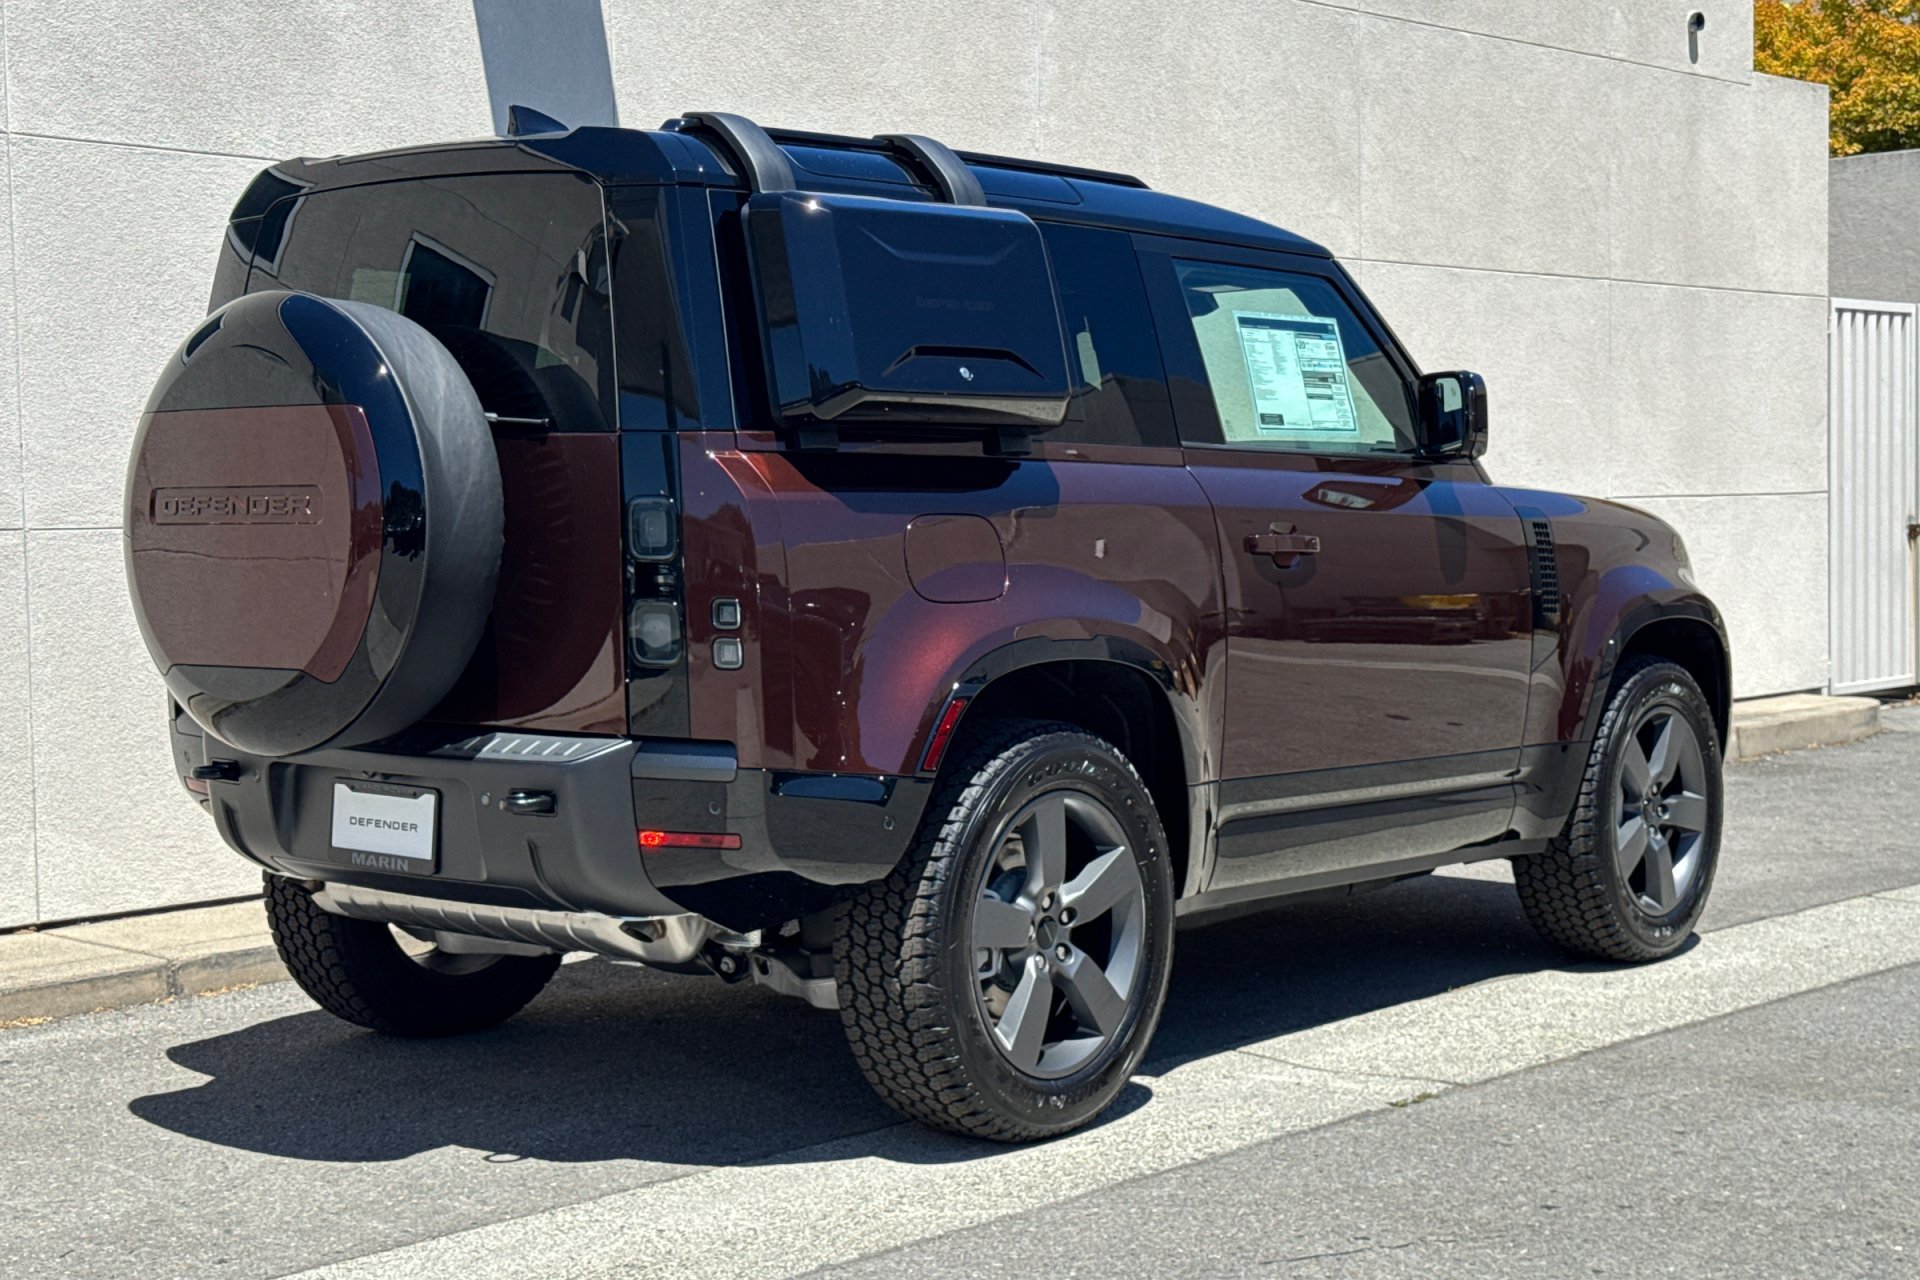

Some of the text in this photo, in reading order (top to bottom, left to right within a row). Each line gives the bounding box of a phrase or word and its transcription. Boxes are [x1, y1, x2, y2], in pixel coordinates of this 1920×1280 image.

[163, 495, 312, 516] DEFENDER
[349, 816, 418, 833] DEFENDER
[351, 851, 409, 873] MARIN
